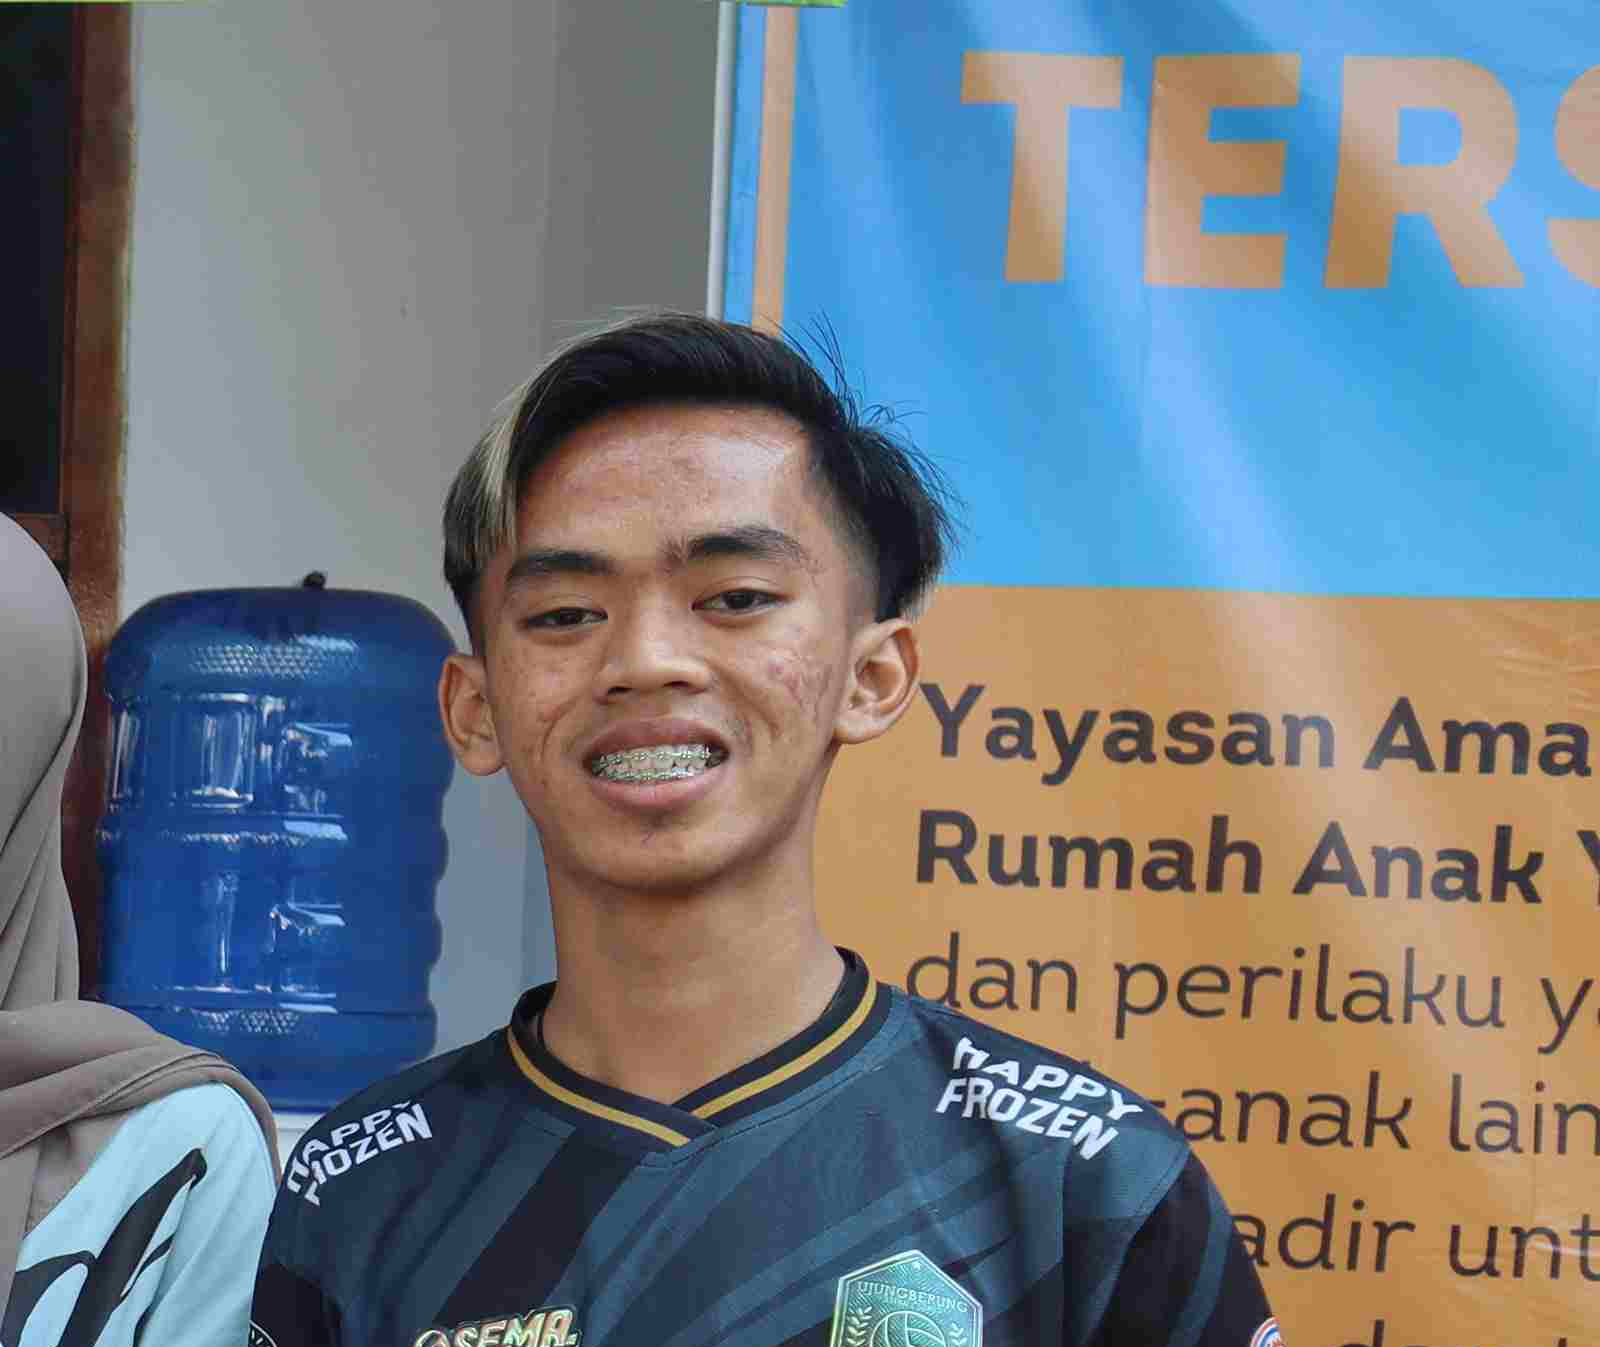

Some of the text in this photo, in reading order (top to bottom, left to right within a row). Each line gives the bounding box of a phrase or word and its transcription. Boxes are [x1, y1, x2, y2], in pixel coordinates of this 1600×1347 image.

[919, 682, 1593, 785] Yayasan Ama
[916, 809, 1262, 895] Rumah
[1292, 821, 1544, 905] Anak
[907, 932, 1080, 1013] dan
[1114, 945, 1505, 1039] perilaku
[936, 1077, 1119, 1161] FROZEN
[953, 1037, 1144, 1120] HAPPY
[1232, 1193, 1600, 1282] adir unt
[857, 1280, 969, 1313] UJUNGBERUNG
